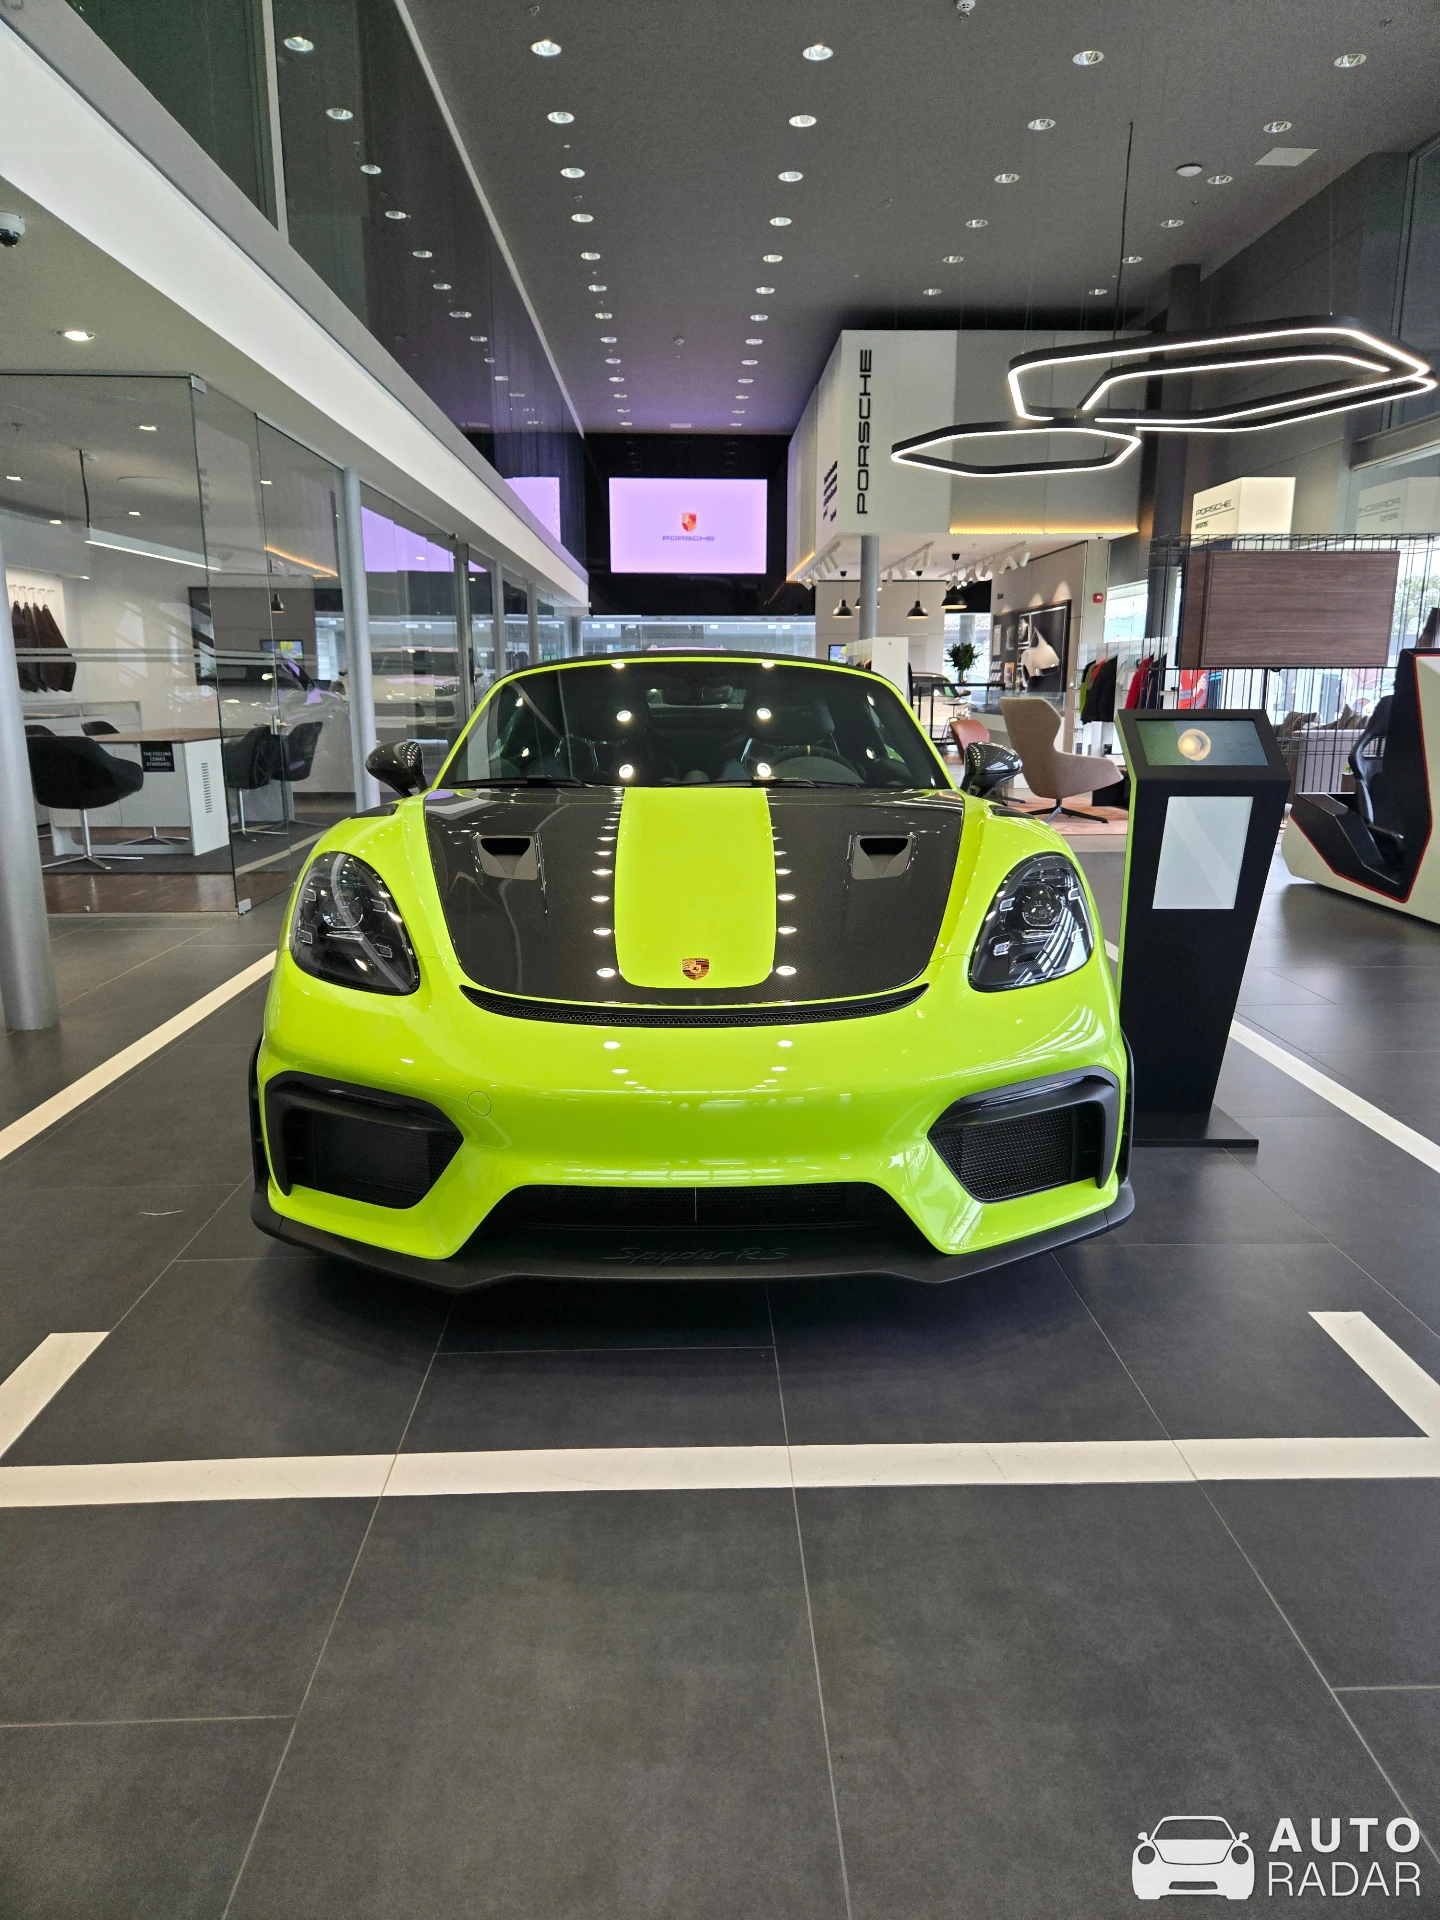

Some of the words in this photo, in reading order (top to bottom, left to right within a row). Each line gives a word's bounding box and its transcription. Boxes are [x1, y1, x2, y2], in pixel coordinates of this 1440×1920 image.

[856, 349, 872, 515] PORSCHE
[1195, 499, 1232, 516] PORSCHE
[603, 1247, 733, 1267] Spyder
[735, 1247, 789, 1260] RS
